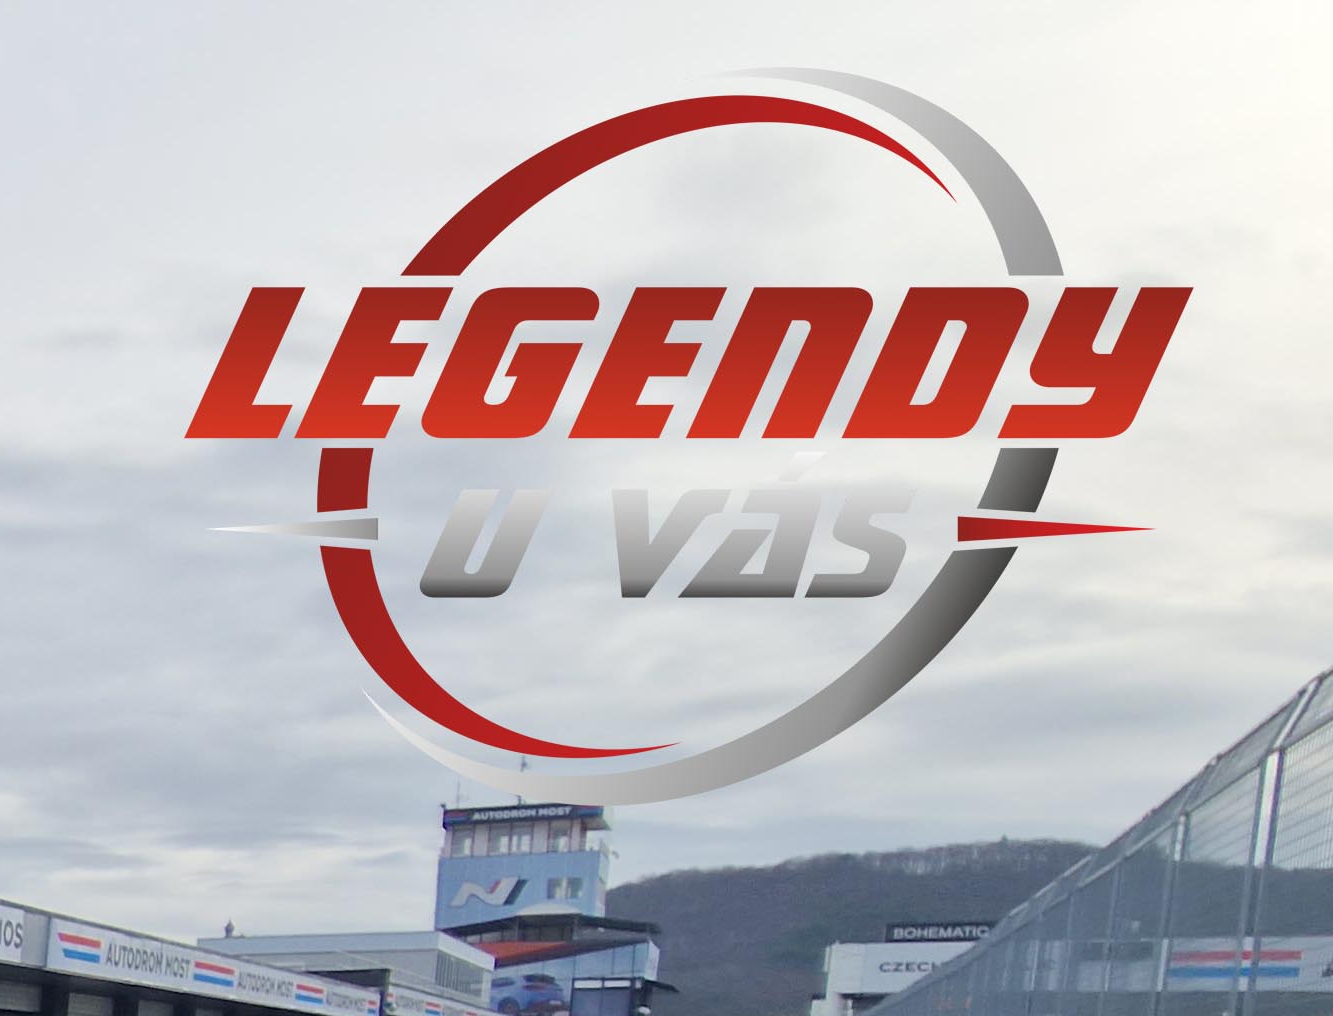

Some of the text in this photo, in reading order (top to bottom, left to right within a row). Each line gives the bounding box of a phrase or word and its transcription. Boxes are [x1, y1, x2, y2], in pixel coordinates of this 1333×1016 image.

[473, 806, 573, 821] AUTODROM MOST
[893, 926, 990, 938] BOHEMATIC
[106, 943, 191, 980] AUTODROM MOST
